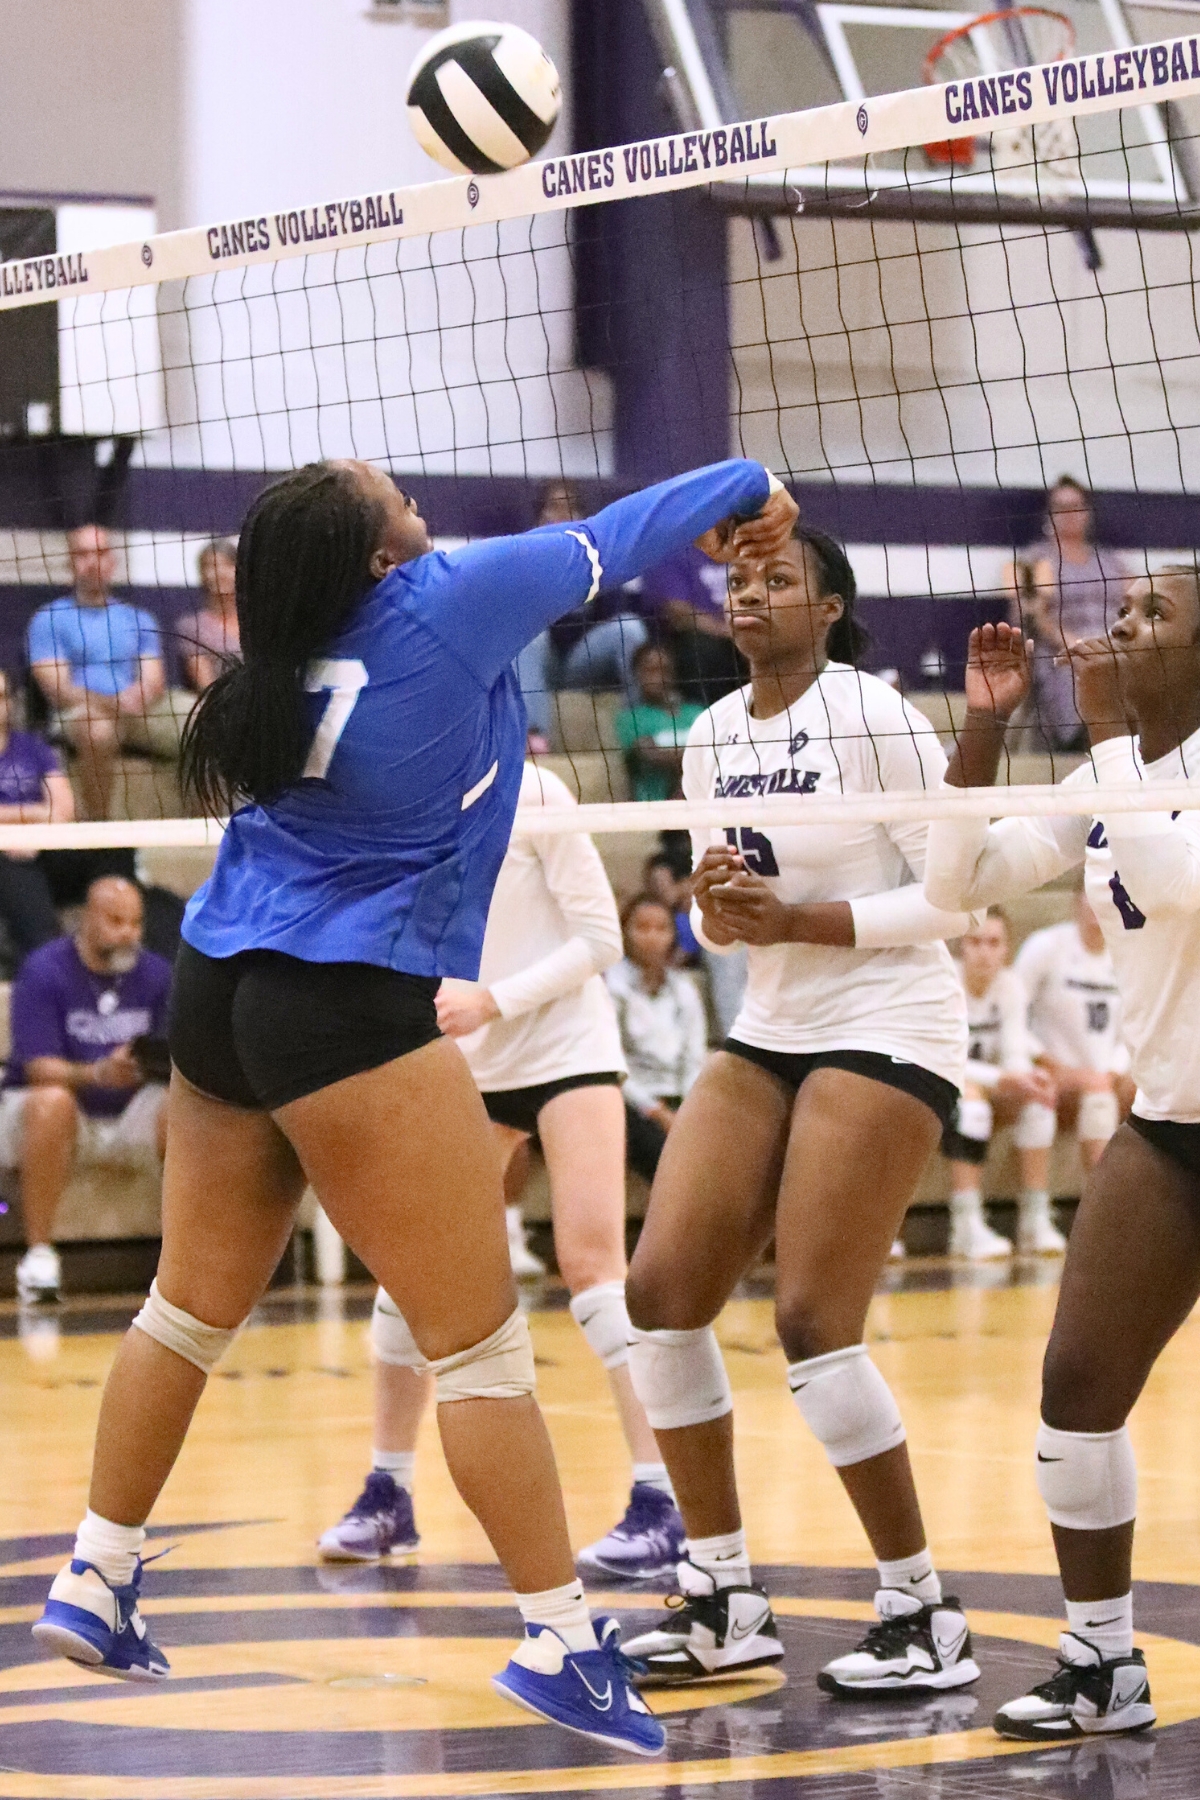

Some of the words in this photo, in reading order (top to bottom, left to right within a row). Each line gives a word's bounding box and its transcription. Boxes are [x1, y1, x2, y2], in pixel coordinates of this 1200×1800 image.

[945, 71, 1033, 124] CANES
[542, 151, 615, 199] CANES
[623, 121, 777, 183] VOLLEYBALL
[206, 217, 270, 259] CANES
[274, 192, 404, 246] VOLLEYBALL
[0, 252, 89, 297] LLEYBALL
[303, 658, 370, 779] 7
